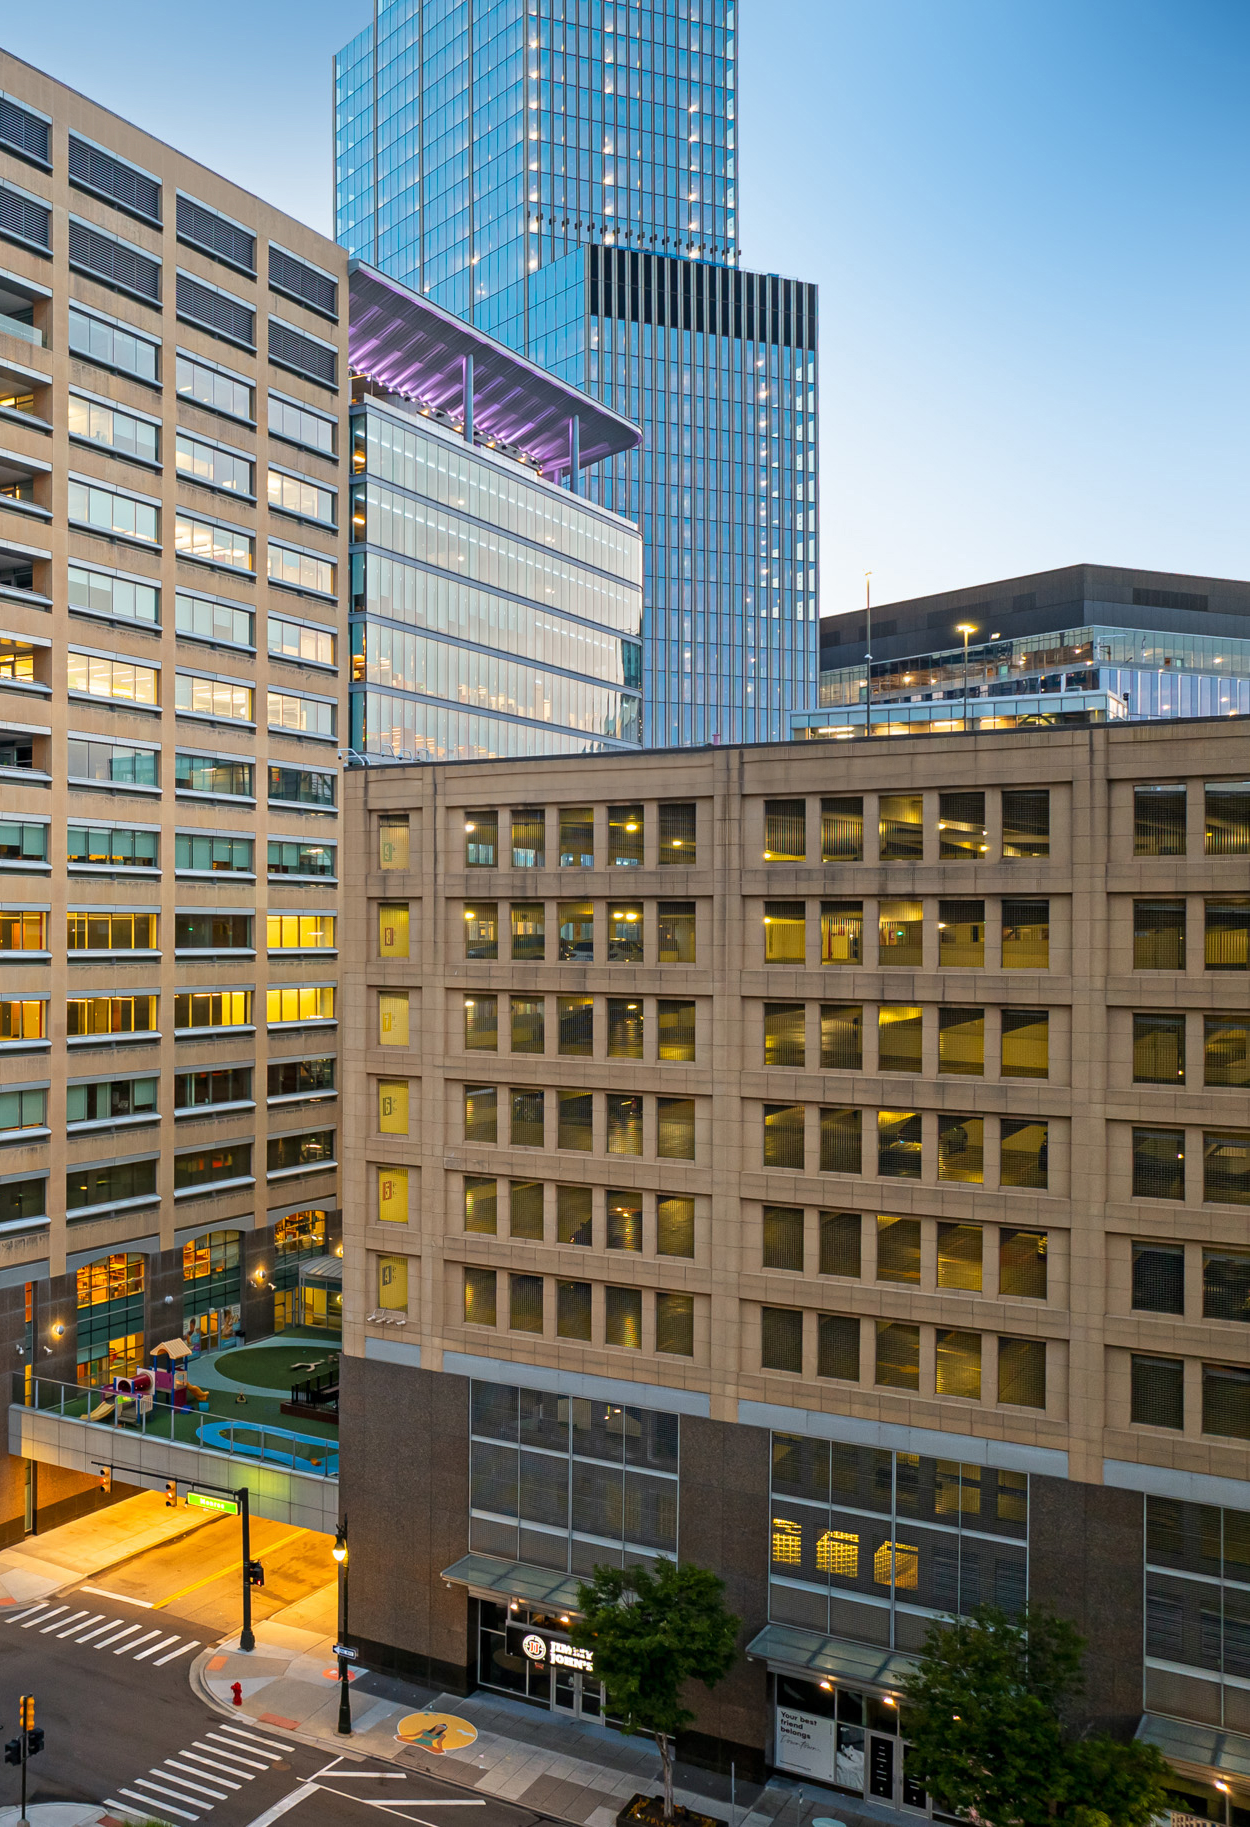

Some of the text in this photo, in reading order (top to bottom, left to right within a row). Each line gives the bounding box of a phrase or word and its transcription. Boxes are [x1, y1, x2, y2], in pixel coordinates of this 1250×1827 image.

[200, 1498, 225, 1509] Monroe
[550, 1653, 594, 1672] JOHN'S
[780, 1719, 803, 1730] friend
[781, 1711, 817, 1726] Your best
[780, 1726, 811, 1739] belongs
